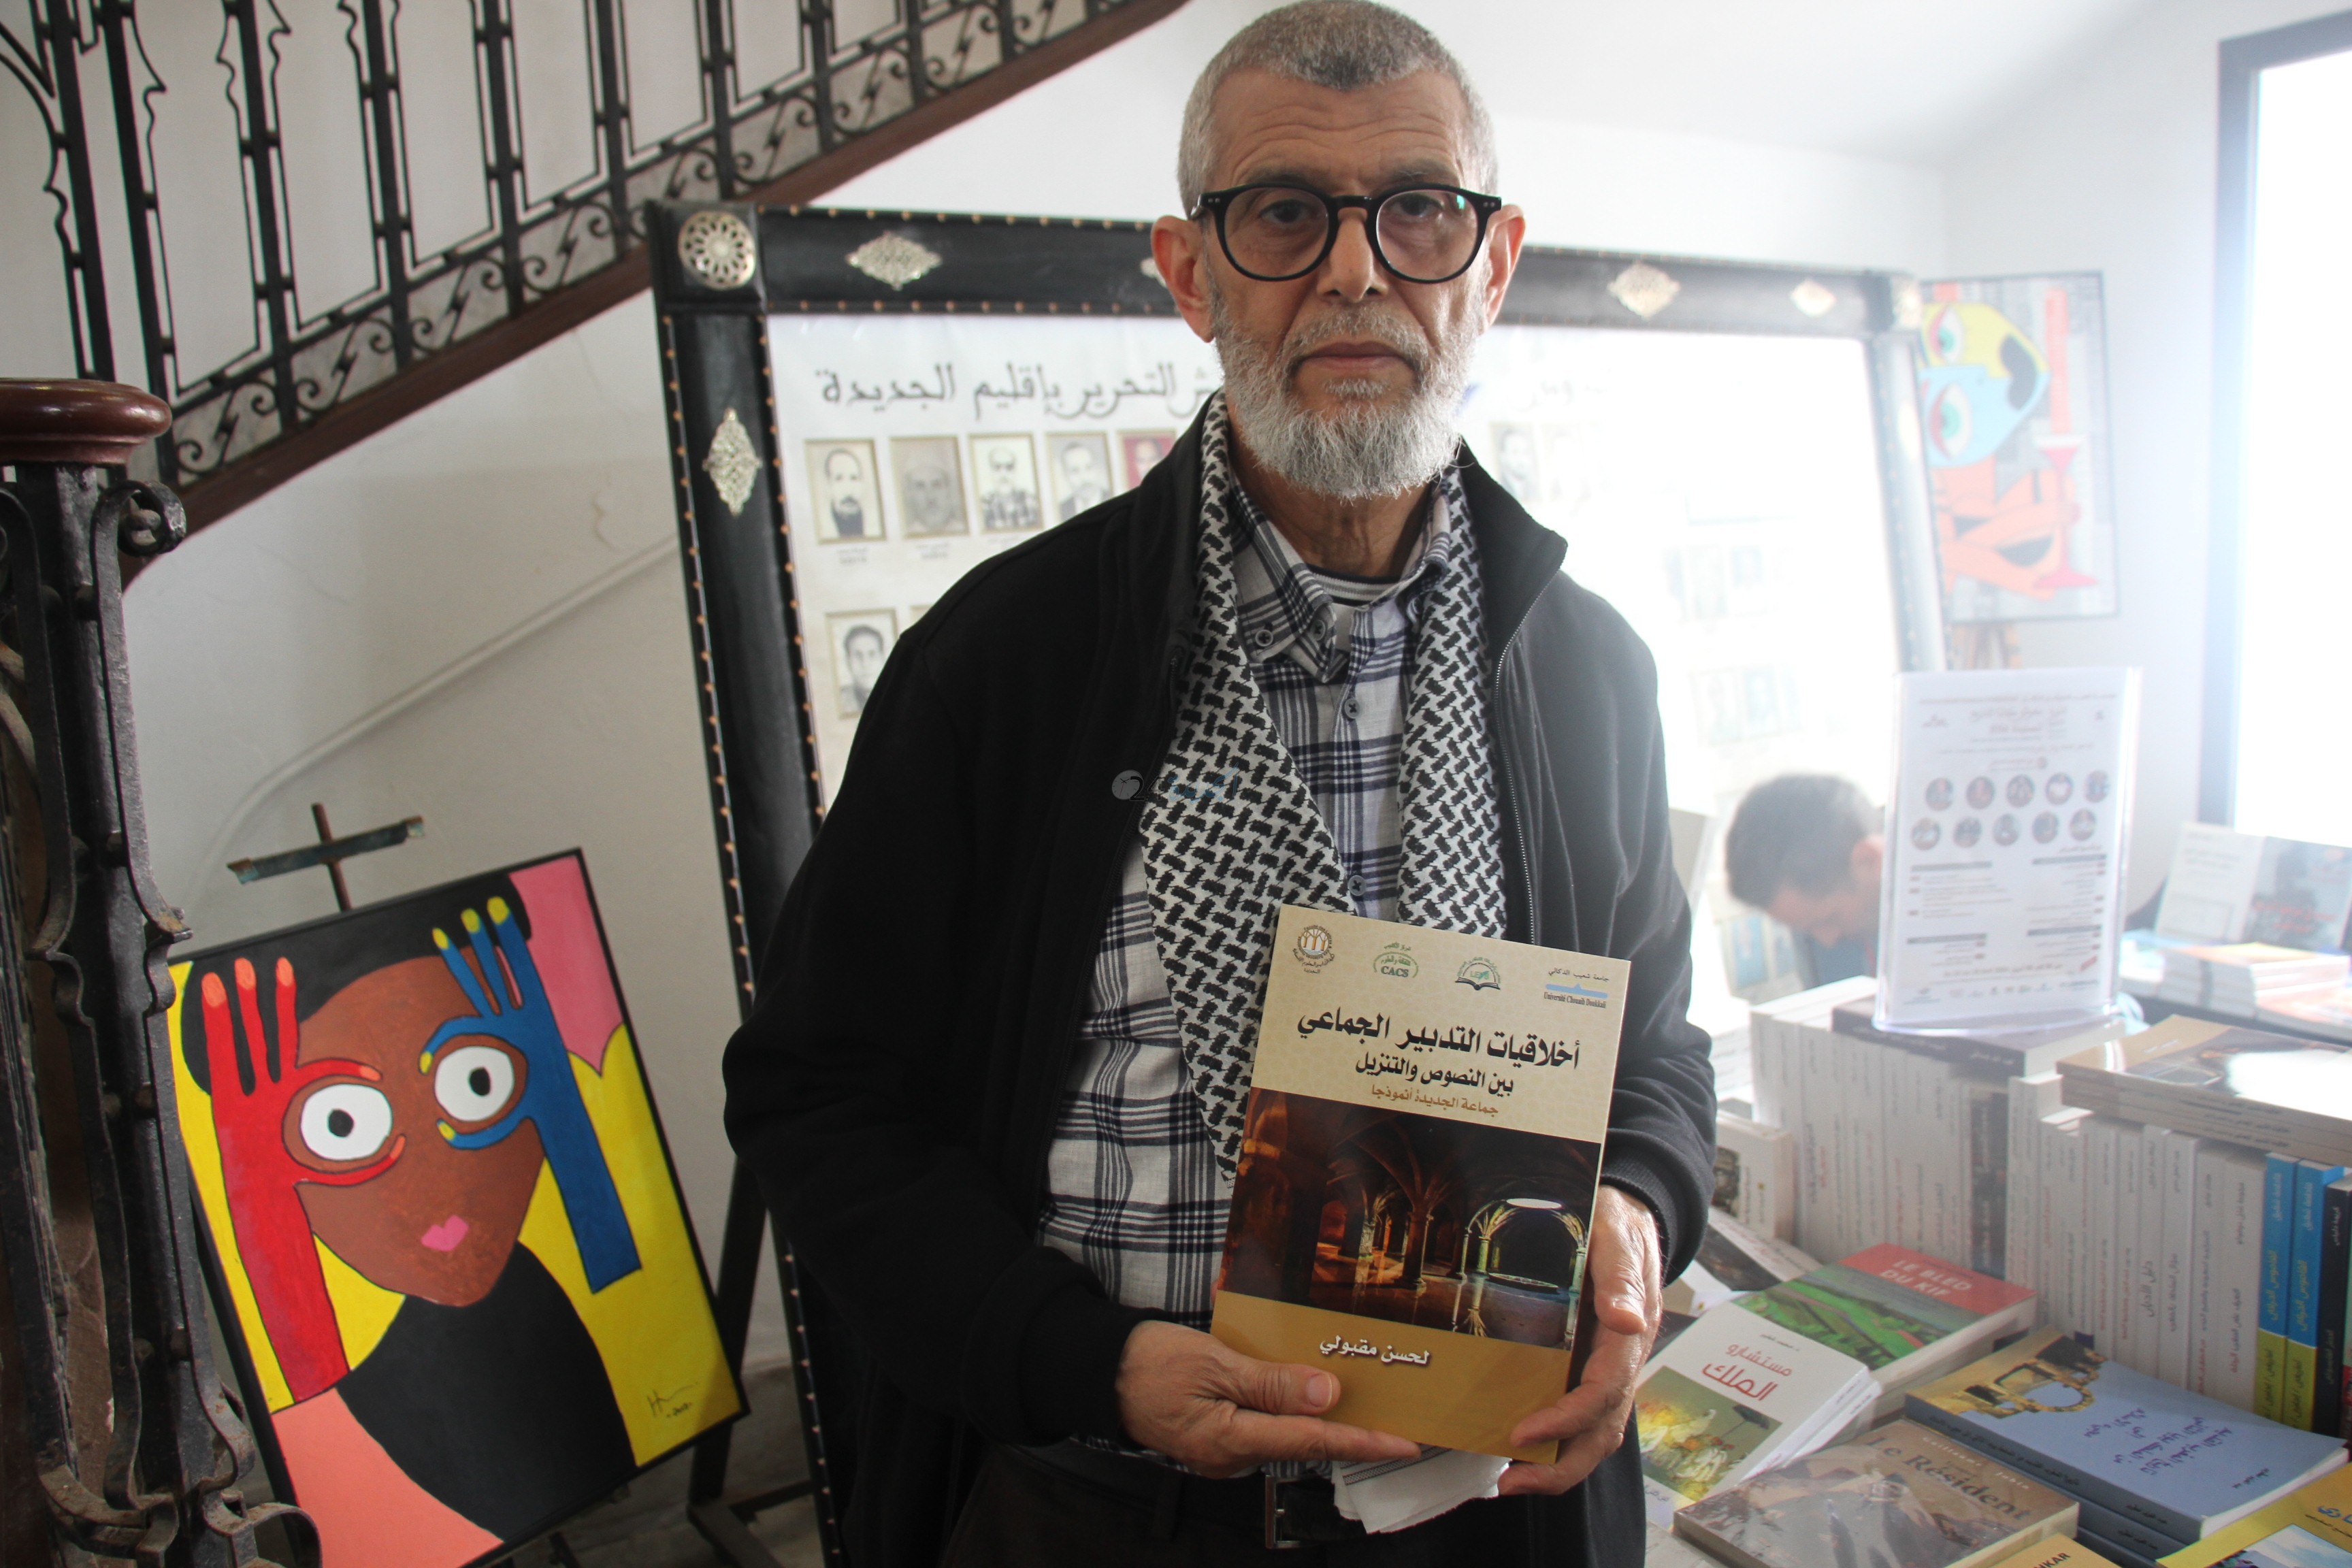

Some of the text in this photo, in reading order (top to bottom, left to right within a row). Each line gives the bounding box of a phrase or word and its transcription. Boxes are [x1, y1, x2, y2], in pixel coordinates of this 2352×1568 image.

[814, 363, 956, 411] الجديدة
[972, 364, 1059, 421] بإقليم
[1045, 363, 1177, 420] التحرير
[1380, 965, 1409, 978] CACS
[1297, 1007, 1580, 1069] أخلاقيات التدبير الجماعي
[1355, 1050, 1514, 1097] بين النصوص والتنزيل
[1414, 1089, 1458, 1108] الجديدة
[1461, 1096, 1499, 1117] جماعة
[1879, 1269, 1950, 1296] DU KIF
[1893, 1259, 1972, 1291] LE BLED
[1319, 1335, 1430, 1365] لحسن مقبولي
[1725, 1343, 1793, 1377] مستشارو
[1701, 1362, 1779, 1402] الملك
[2131, 1441, 2163, 1458] الملك
[2170, 1443, 2200, 1463] المغرب
[1866, 1436, 1903, 1456] Le
[1901, 1454, 2034, 1521] Résident
